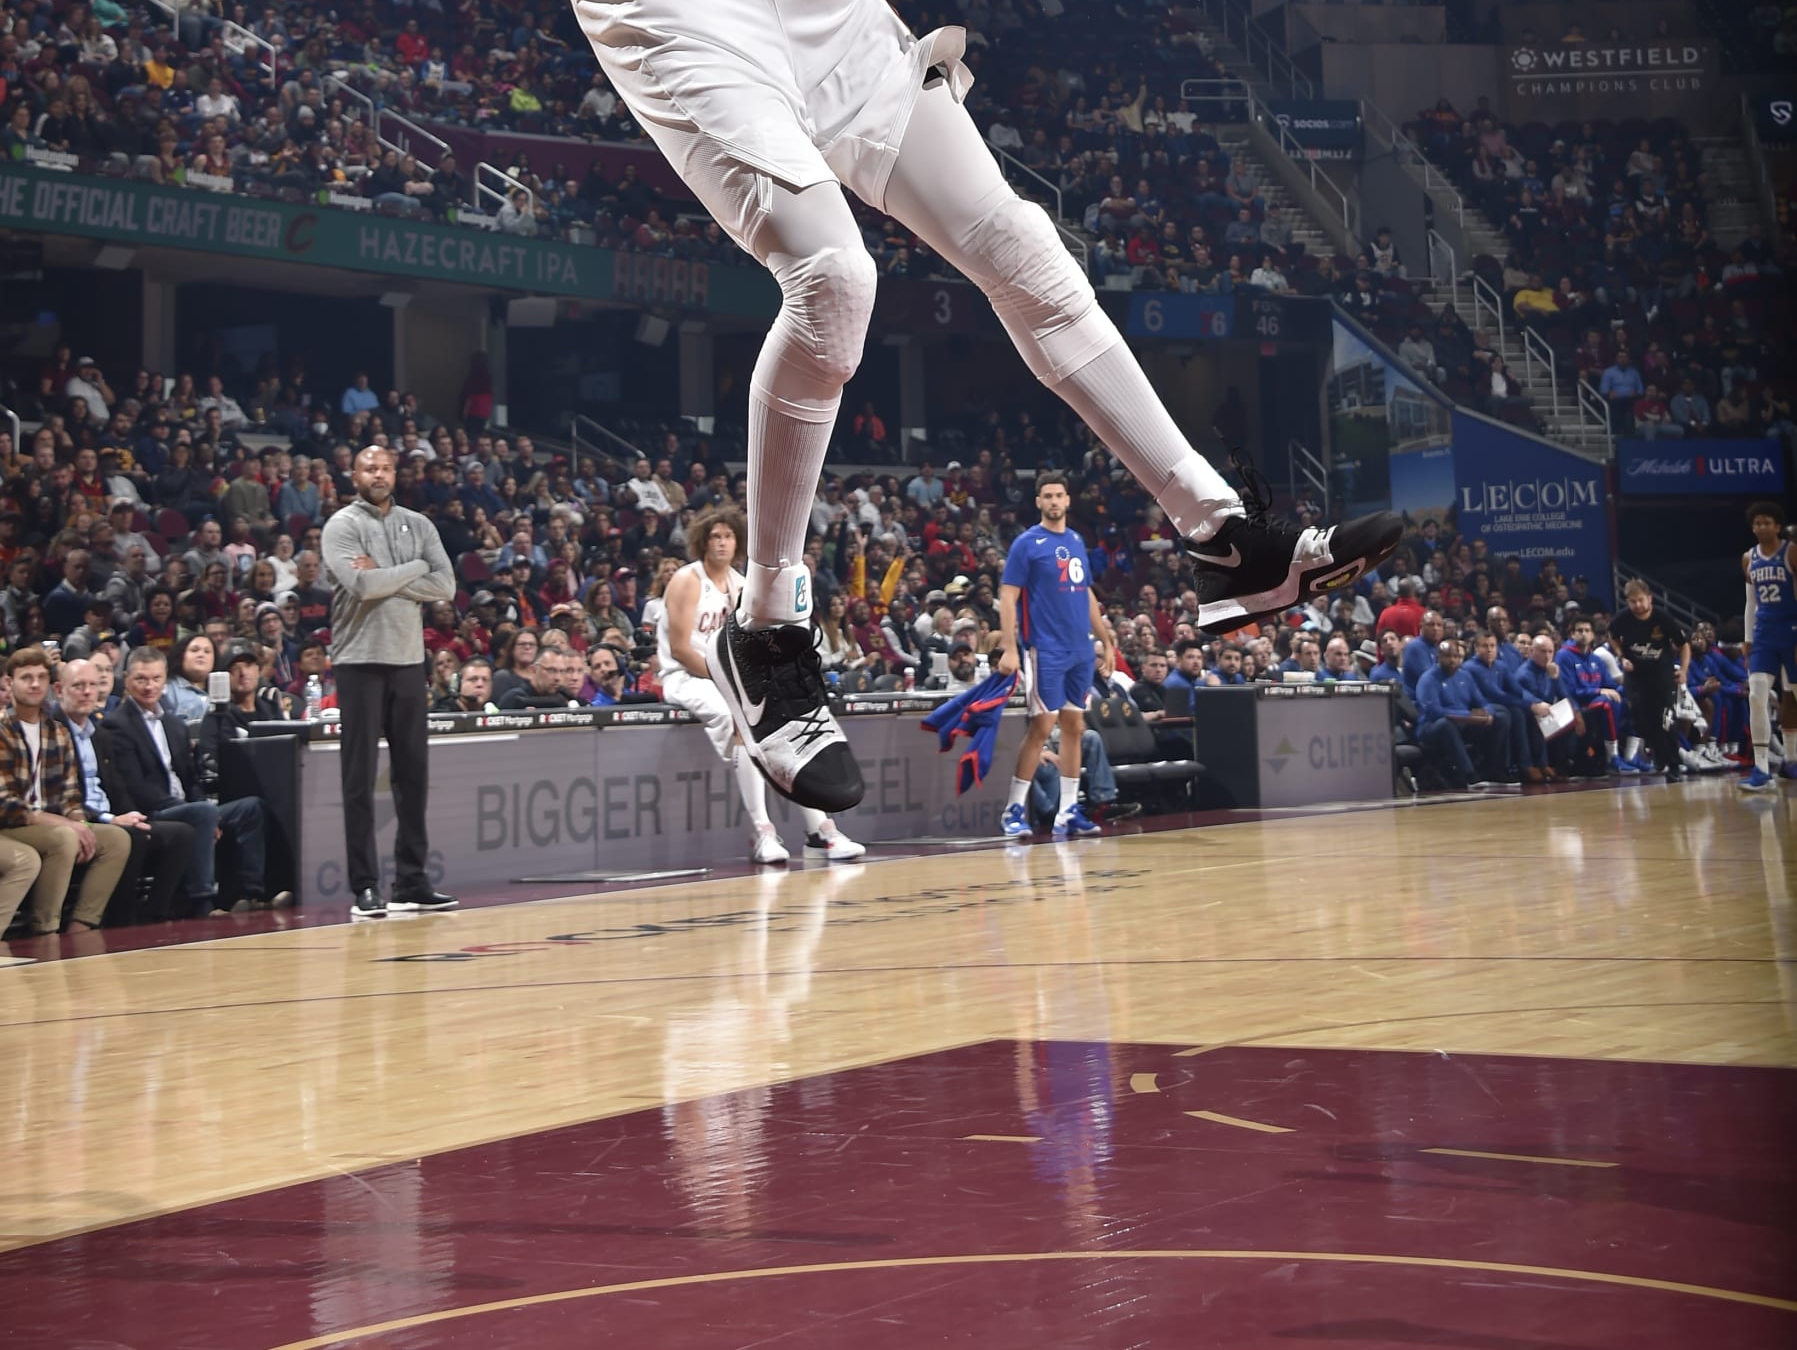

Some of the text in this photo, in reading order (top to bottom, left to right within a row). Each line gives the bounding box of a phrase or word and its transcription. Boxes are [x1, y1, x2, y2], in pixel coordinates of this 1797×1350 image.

[1543, 47, 1699, 68] WESTFIELD
[1516, 77, 1701, 96] CHAMPIONS CLUB
[31, 180, 139, 231] OFFICIAL
[146, 195, 221, 241] CRAFT
[225, 205, 282, 249] BEER
[359, 225, 579, 286] HAZECRAFT IPA
[934, 290, 951, 324] 3
[1143, 299, 1164, 332] 6
[1200, 311, 1227, 336] 76
[1256, 316, 1280, 336] 46
[1709, 457, 1776, 475] ULTRA
[1056, 557, 1085, 584] 76
[1750, 566, 1787, 583] PHILA
[1758, 583, 1781, 603] 22
[1309, 732, 1390, 770] CLIFFS
[477, 774, 662, 852] BIGGER
